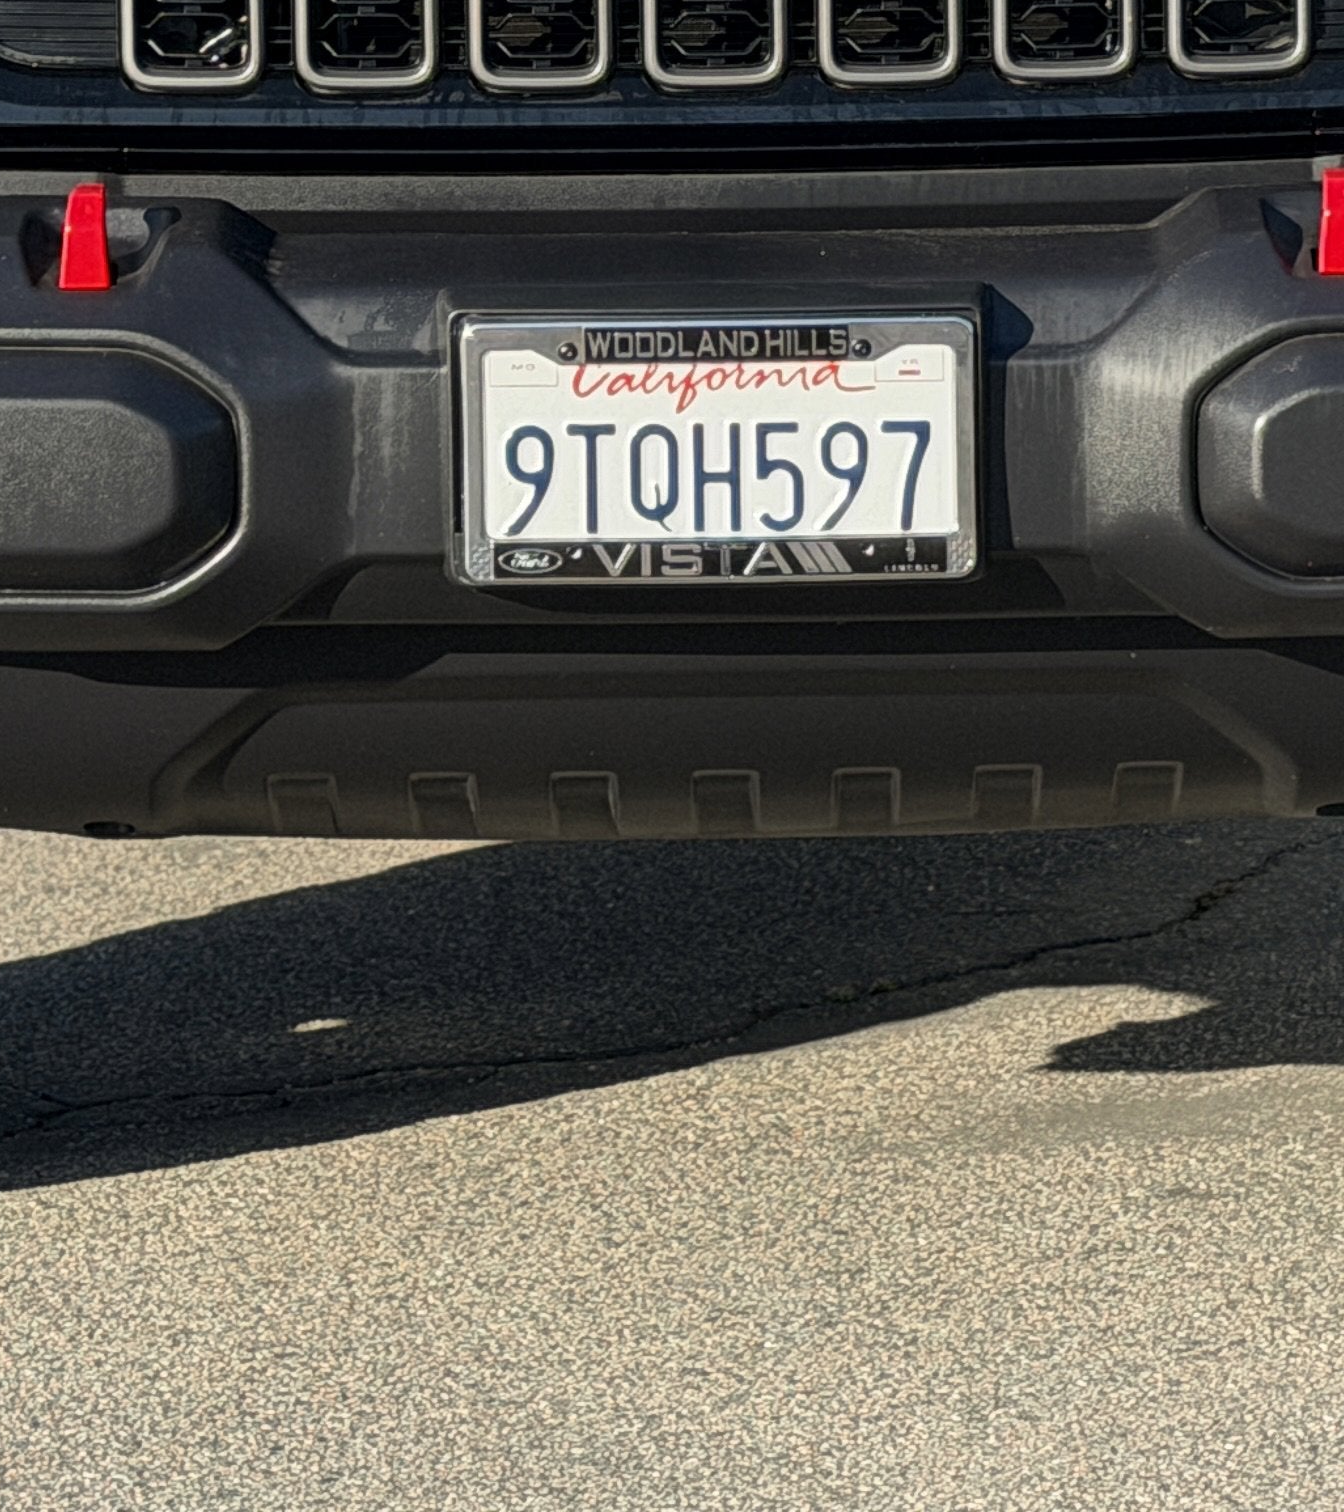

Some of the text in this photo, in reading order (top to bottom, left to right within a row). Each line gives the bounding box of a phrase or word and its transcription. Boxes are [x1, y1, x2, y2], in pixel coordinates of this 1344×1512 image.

[586, 329, 848, 359] WOODLAND HILLS
[505, 420, 931, 536] 9TQH597
[592, 543, 793, 576] VISTA
